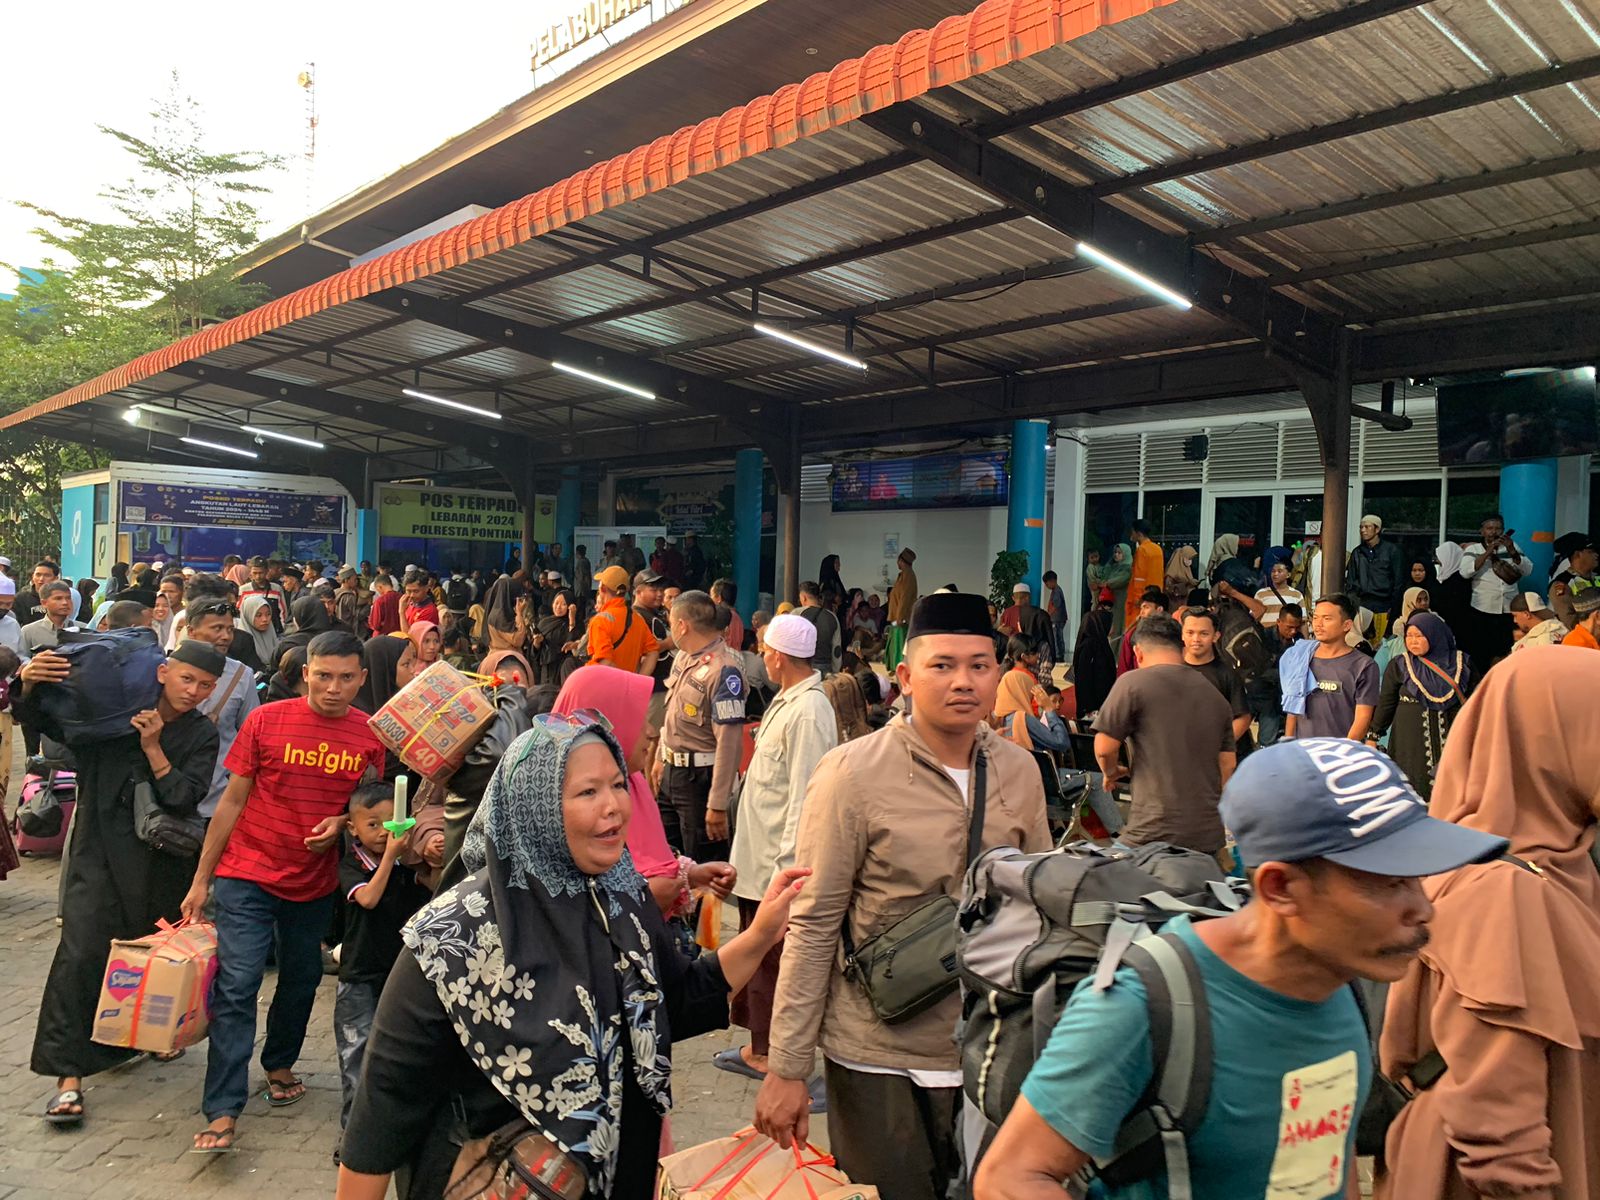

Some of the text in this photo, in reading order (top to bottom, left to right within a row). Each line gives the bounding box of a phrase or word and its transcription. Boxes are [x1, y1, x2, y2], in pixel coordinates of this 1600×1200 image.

[420, 492, 454, 508] POS
[431, 511, 515, 526] LEBARAN 2024
[412, 524, 469, 537] POLRESTA
[283, 742, 363, 775] Insight
[415, 747, 438, 770] 40
